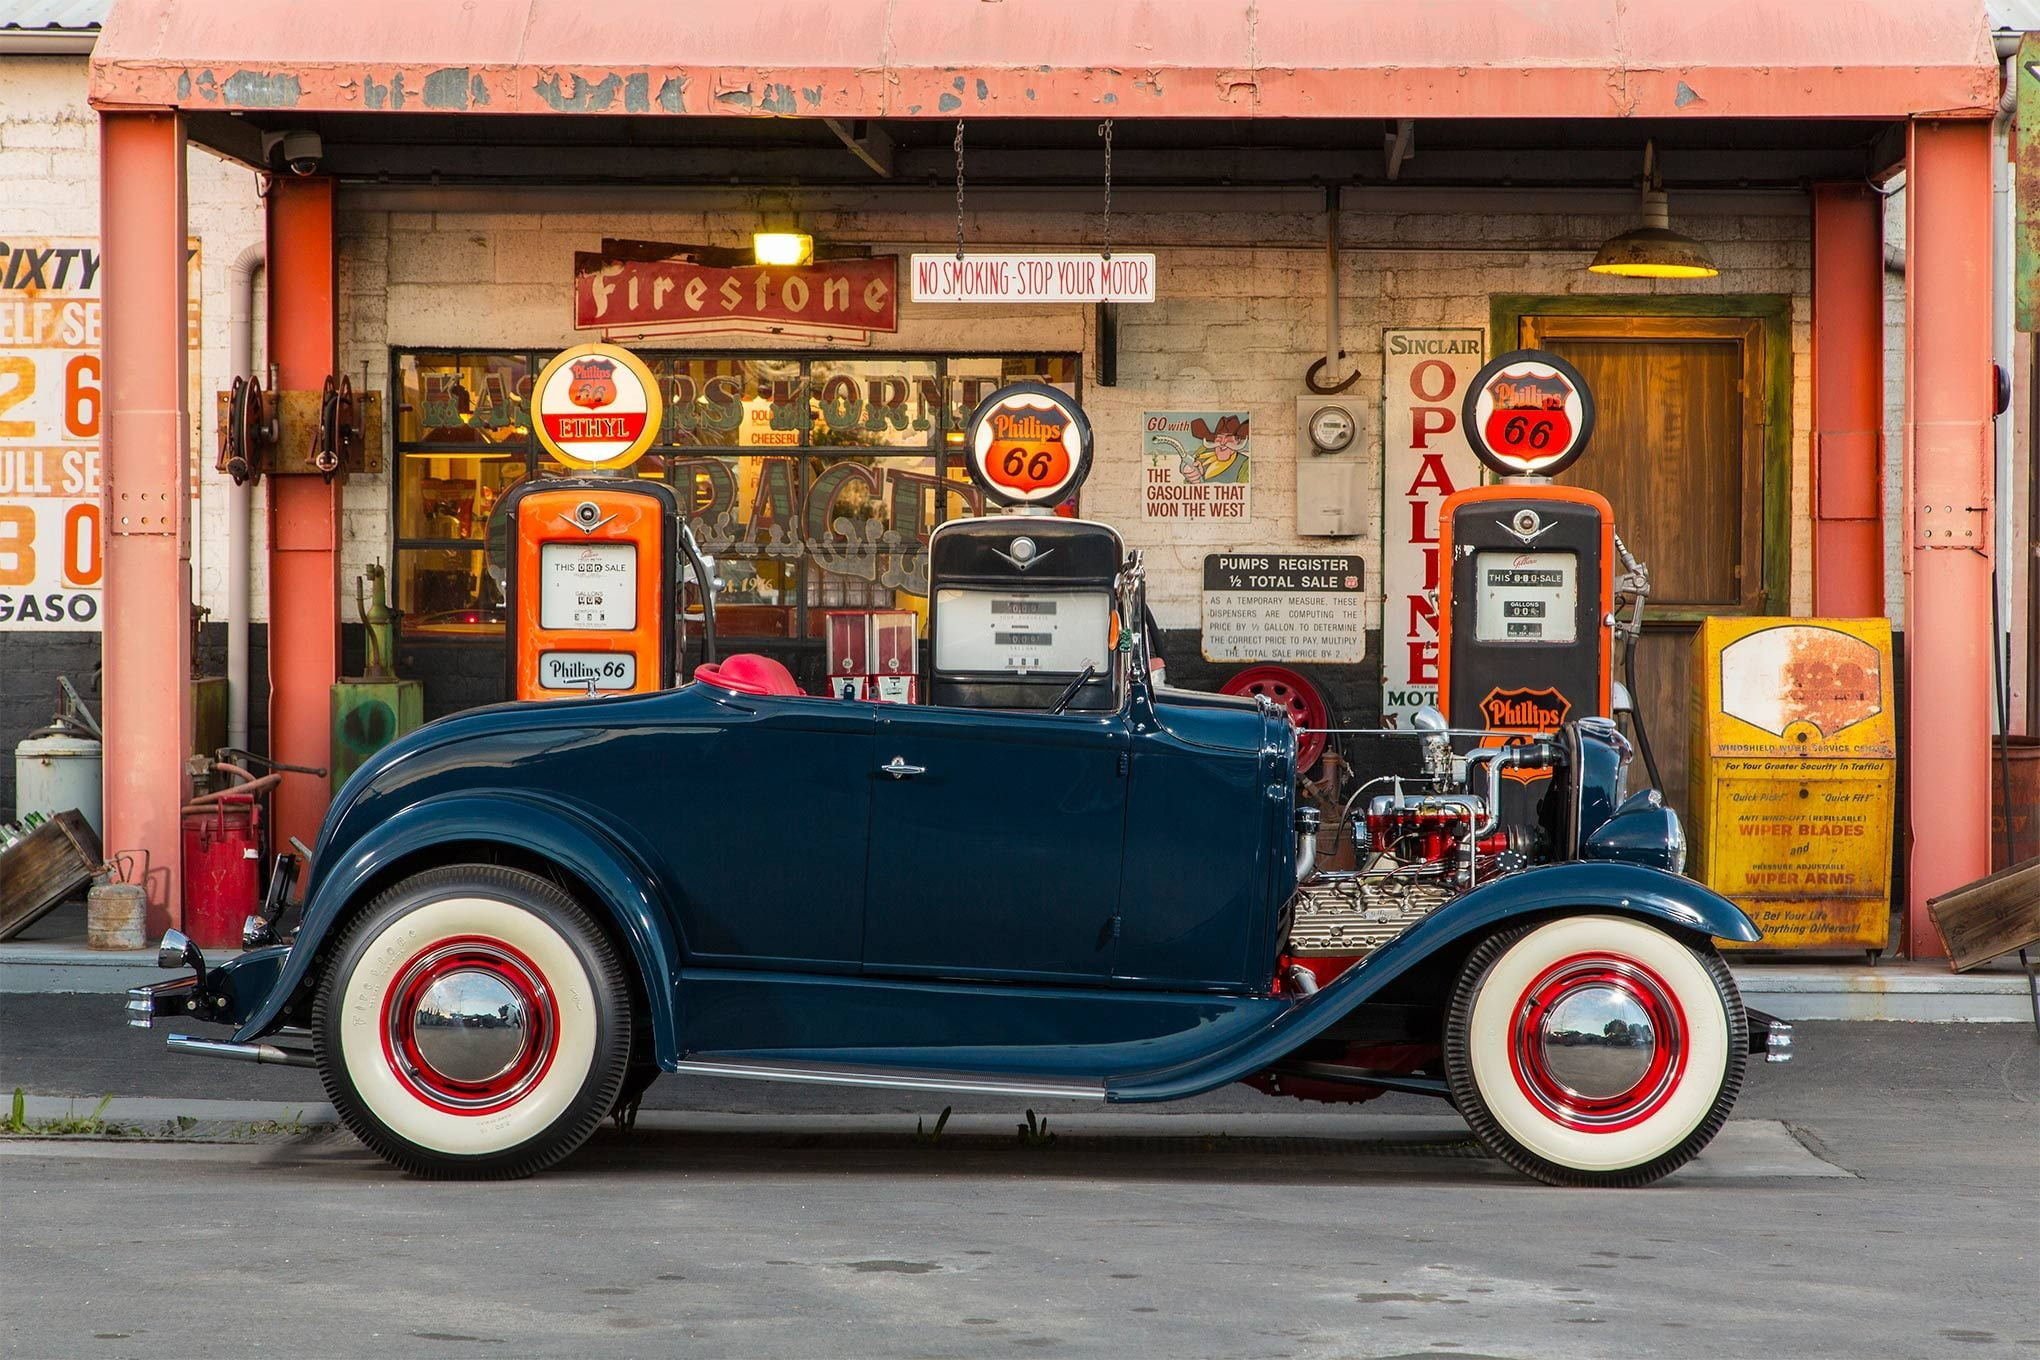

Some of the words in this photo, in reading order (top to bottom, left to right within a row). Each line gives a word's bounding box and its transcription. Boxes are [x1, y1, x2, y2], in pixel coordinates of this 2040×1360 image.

[919, 261, 938, 295] NO
[1058, 261, 1095, 295] YOUR
[1101, 261, 1148, 295] MOTOR
[591, 263, 889, 319] Firestone
[0, 302, 53, 345] ELF
[1494, 382, 1562, 411] Phillips
[559, 418, 630, 438] ETHYL
[994, 413, 1061, 445] Phillips
[1147, 417, 1167, 431] GO
[1167, 420, 1190, 431] with
[1504, 415, 1554, 450] 66
[1002, 446, 1053, 481] 66
[0, 451, 52, 493] ULL
[1147, 468, 1171, 483] THE
[1147, 485, 1210, 500] GASOLINE
[1214, 485, 1245, 500] THAT
[1147, 502, 1179, 517] WON
[1182, 502, 1206, 517] THE
[1210, 502, 1246, 517] WEST
[1405, 359, 1457, 685] OPALINE
[555, 564, 575, 572] THIS
[605, 564, 627, 572] SALE
[1220, 558, 1269, 570] PUMPS
[1279, 559, 1349, 571] REGISTER
[1249, 576, 1294, 587] TOTAL
[1302, 576, 1338, 588] SALE
[1489, 574, 1511, 582] THIS
[1540, 574, 1562, 583] SALE
[1210, 597, 1221, 605] AS
[1226, 597, 1232, 605] A
[1238, 597, 1283, 605] TEMPORARY
[1333, 598, 1358, 606] THESE
[1210, 610, 1257, 618] DISPENSERS
[1343, 611, 1357, 619] THE
[1210, 623, 1231, 631] PRICE
[1236, 623, 1246, 631] BY
[1314, 624, 1357, 632] DETERMINE
[1210, 636, 1225, 644] THE
[1228, 636, 1262, 644] CORRECT
[1265, 636, 1287, 645] PRICE
[1290, 637, 1299, 645] TO
[1322, 636, 1357, 645] MULTIPLY
[1225, 649, 1239, 657] THE
[1245, 649, 1268, 657] TOTAL
[1296, 649, 1317, 657] PRICE
[549, 659, 601, 681] Phillips
[603, 661, 626, 678] 66
[1387, 691, 1438, 706] MOT
[1489, 699, 1560, 734] Phillips
[1718, 744, 1775, 752] WINDSHIELD
[1812, 744, 1849, 752] SERVICE
[1764, 763, 1799, 771] Greater
[1800, 763, 1838, 772] Security
[1739, 824, 1793, 836] WIPER
[1798, 825, 1864, 836] BLADES
[1789, 842, 1810, 856] and
[1745, 872, 1802, 885] WIPER
[1804, 872, 1856, 885] ARMS
[1763, 911, 1781, 920] Bet
[1784, 911, 1807, 920] Your
[1809, 911, 1828, 920] Life
[1762, 923, 1806, 935] Anything
[1809, 923, 1861, 933] Different!
